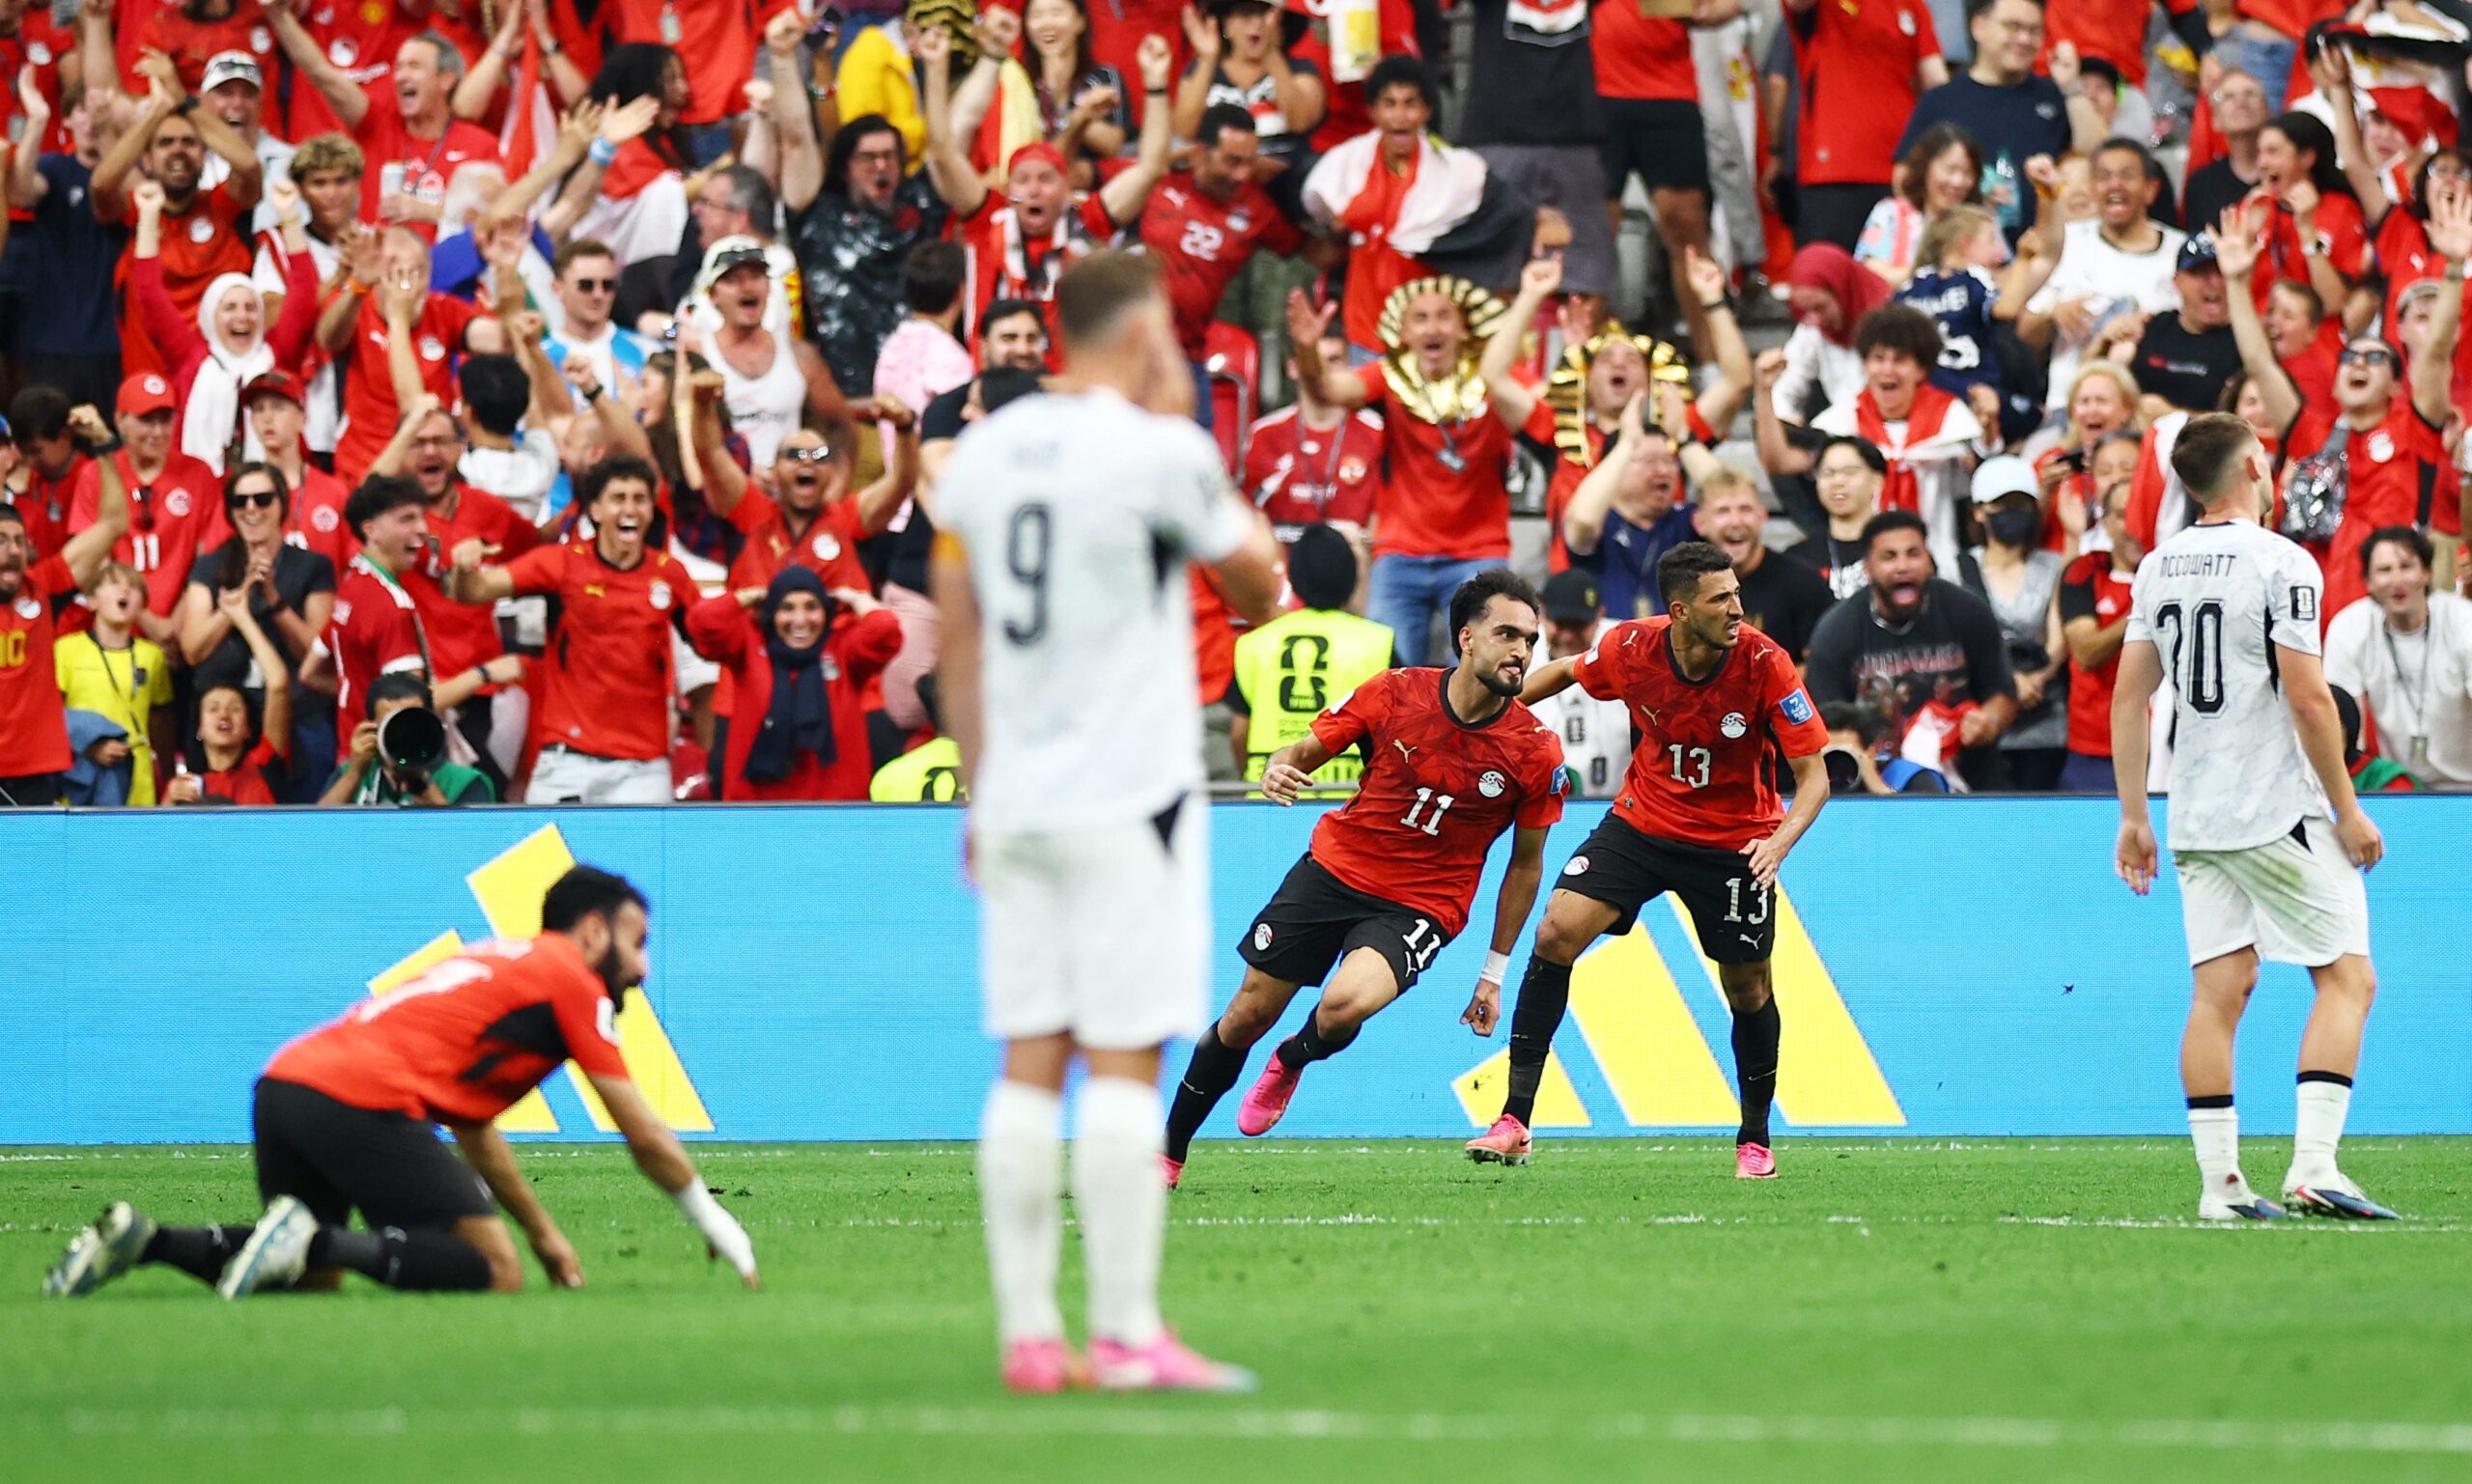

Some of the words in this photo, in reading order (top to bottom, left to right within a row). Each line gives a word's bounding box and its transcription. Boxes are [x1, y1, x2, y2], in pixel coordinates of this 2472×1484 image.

[1180, 218, 1224, 262] 22
[132, 533, 160, 573] 11
[1004, 503, 1050, 645] 9
[1669, 743, 1711, 789] 13
[1400, 787, 1455, 836] 11
[1724, 878, 1769, 925] 13
[1402, 918, 1442, 969] 11
